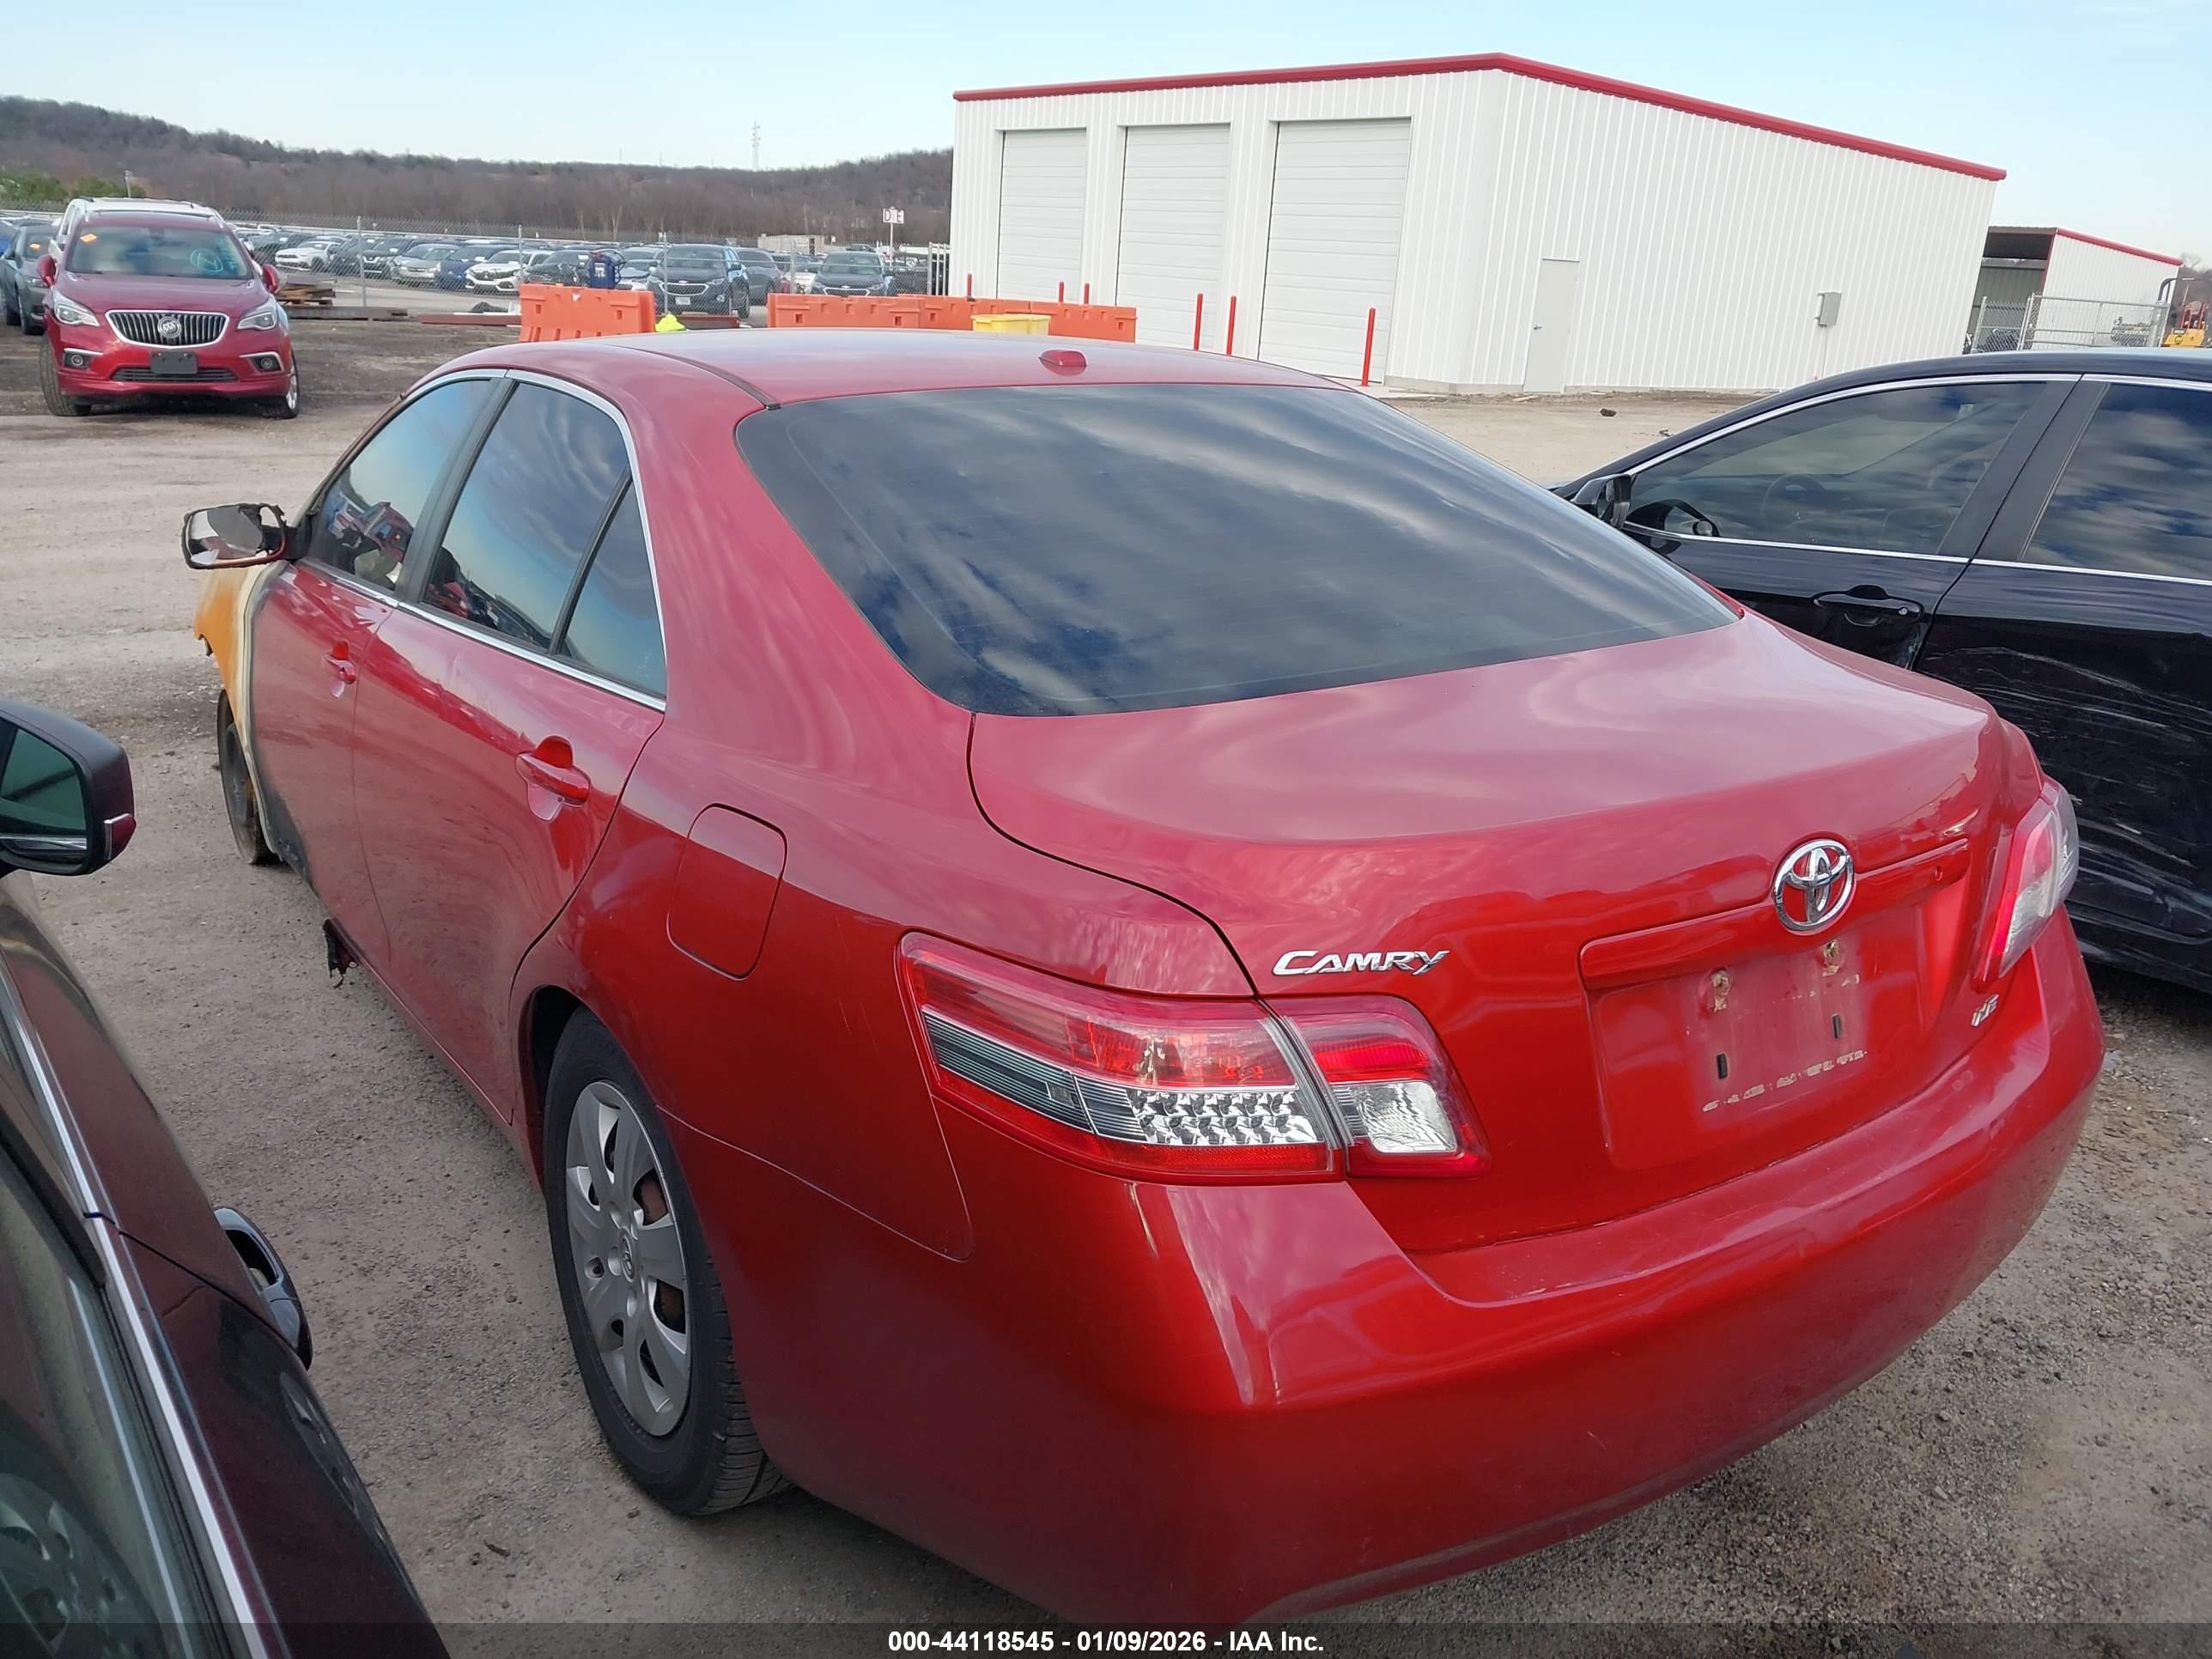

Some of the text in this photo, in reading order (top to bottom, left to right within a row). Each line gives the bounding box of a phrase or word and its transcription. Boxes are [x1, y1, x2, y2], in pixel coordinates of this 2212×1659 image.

[884, 210, 890, 222] D
[1273, 950, 1450, 975] CAMRY
[1971, 994, 2000, 1027] LE
